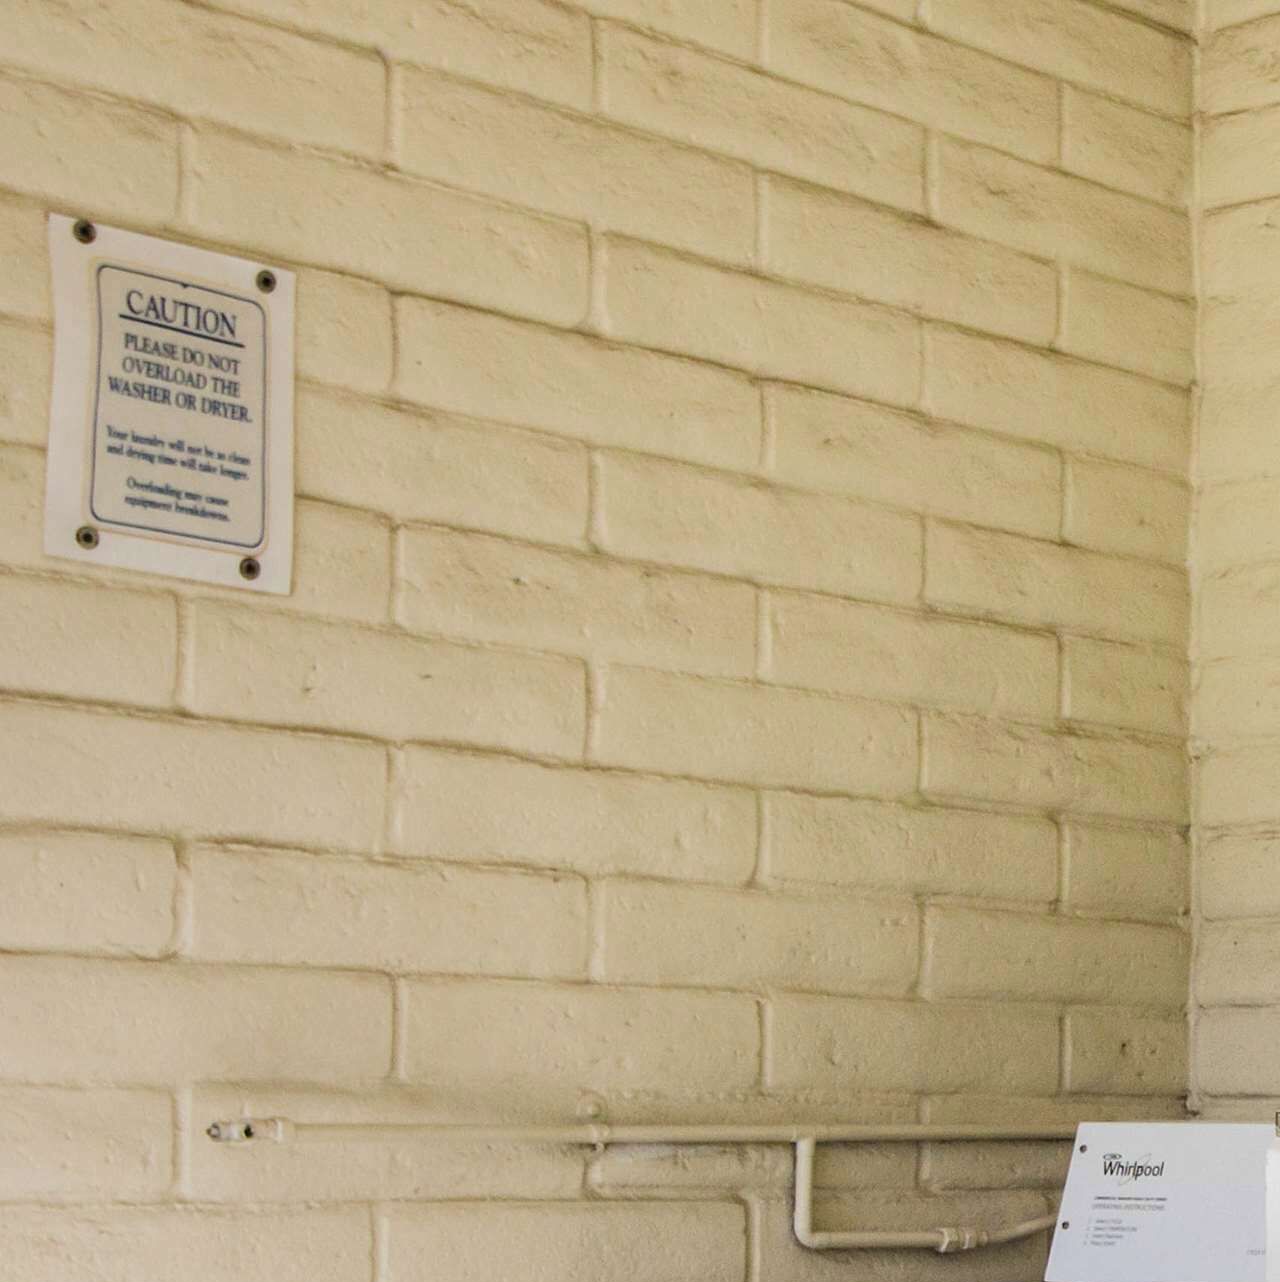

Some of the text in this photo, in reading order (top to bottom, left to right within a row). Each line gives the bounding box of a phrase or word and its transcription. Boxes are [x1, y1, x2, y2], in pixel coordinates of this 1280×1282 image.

[126, 290, 238, 338] CAUTION
[124, 332, 240, 375] PLEASE DO NOT
[122, 356, 241, 398] OVERLOAD THE
[108, 375, 253, 422] WASHER OR DRYER.
[127, 476, 183, 500] Overloading
[1103, 1161, 1165, 1181] Whirlpool
